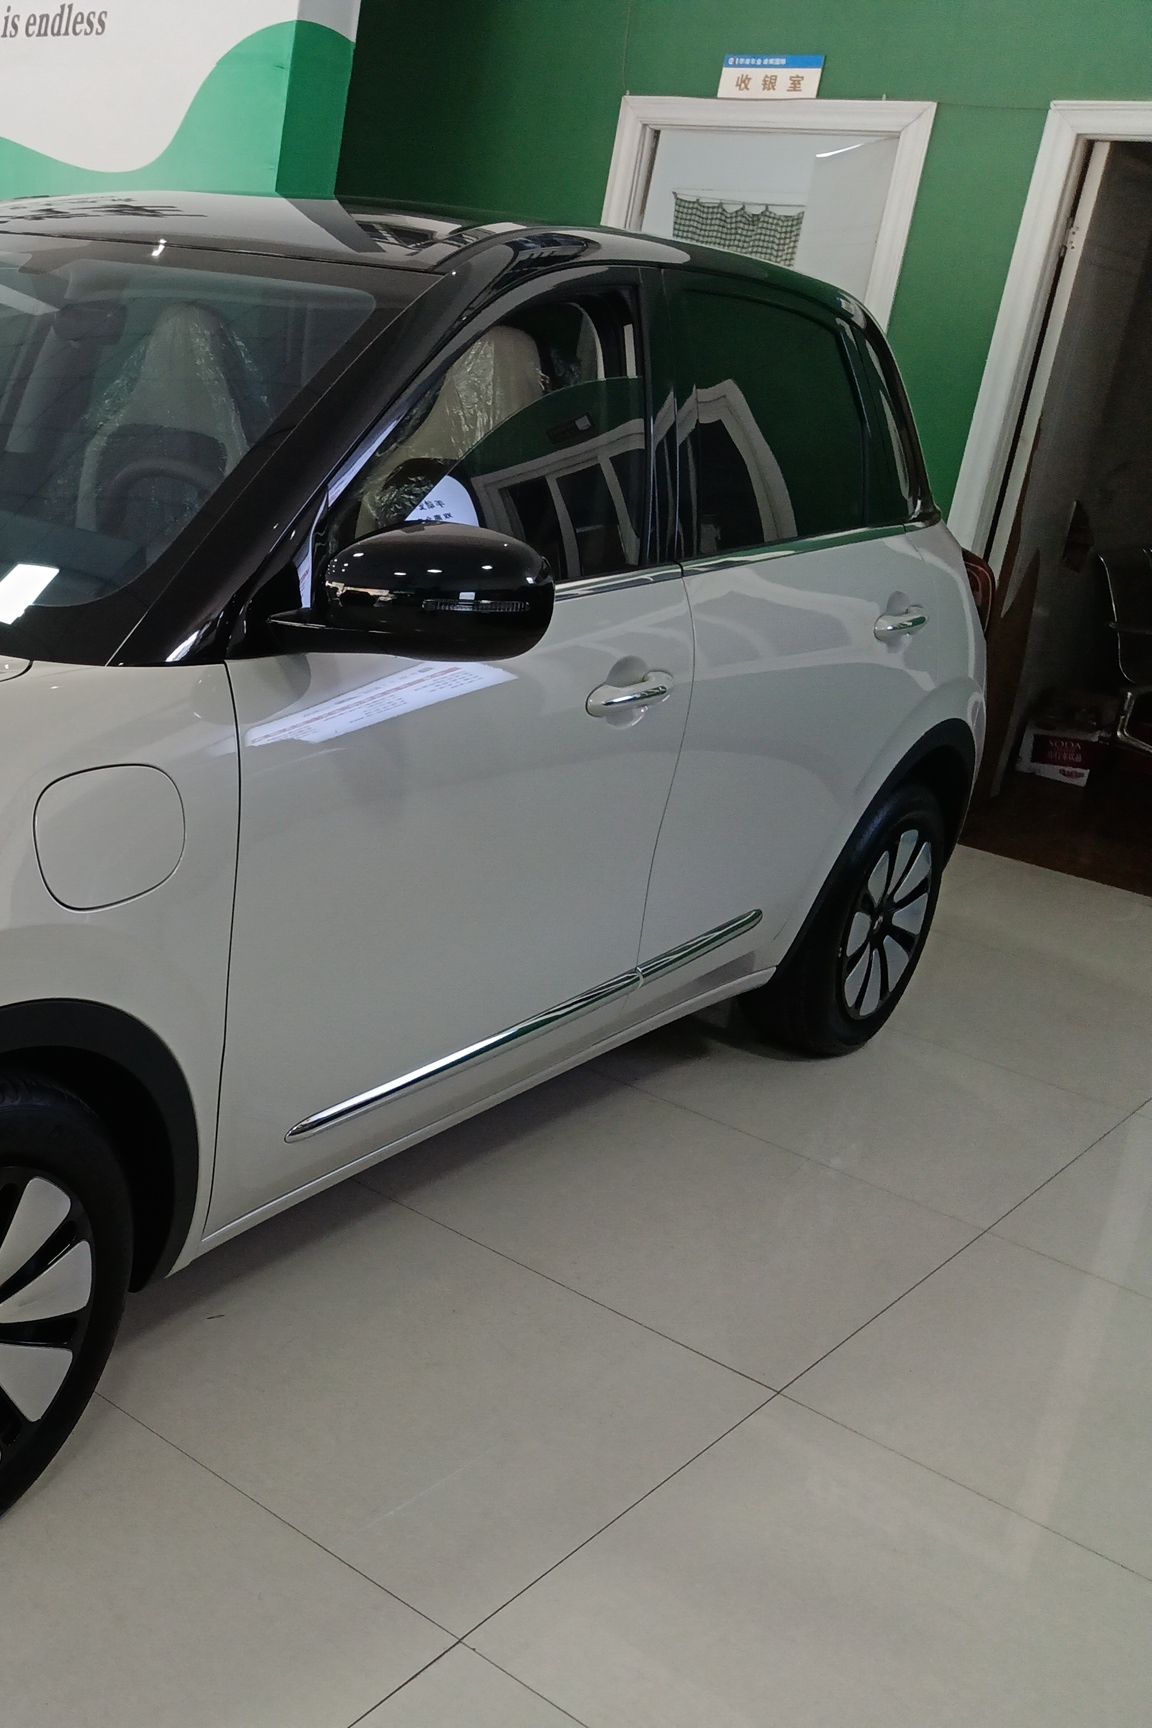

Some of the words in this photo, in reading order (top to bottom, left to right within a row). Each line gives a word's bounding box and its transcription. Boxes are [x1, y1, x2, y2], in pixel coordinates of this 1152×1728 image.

[0, 5, 21, 39] is
[25, 3, 108, 38] endless
[735, 74, 805, 92] 收银室
